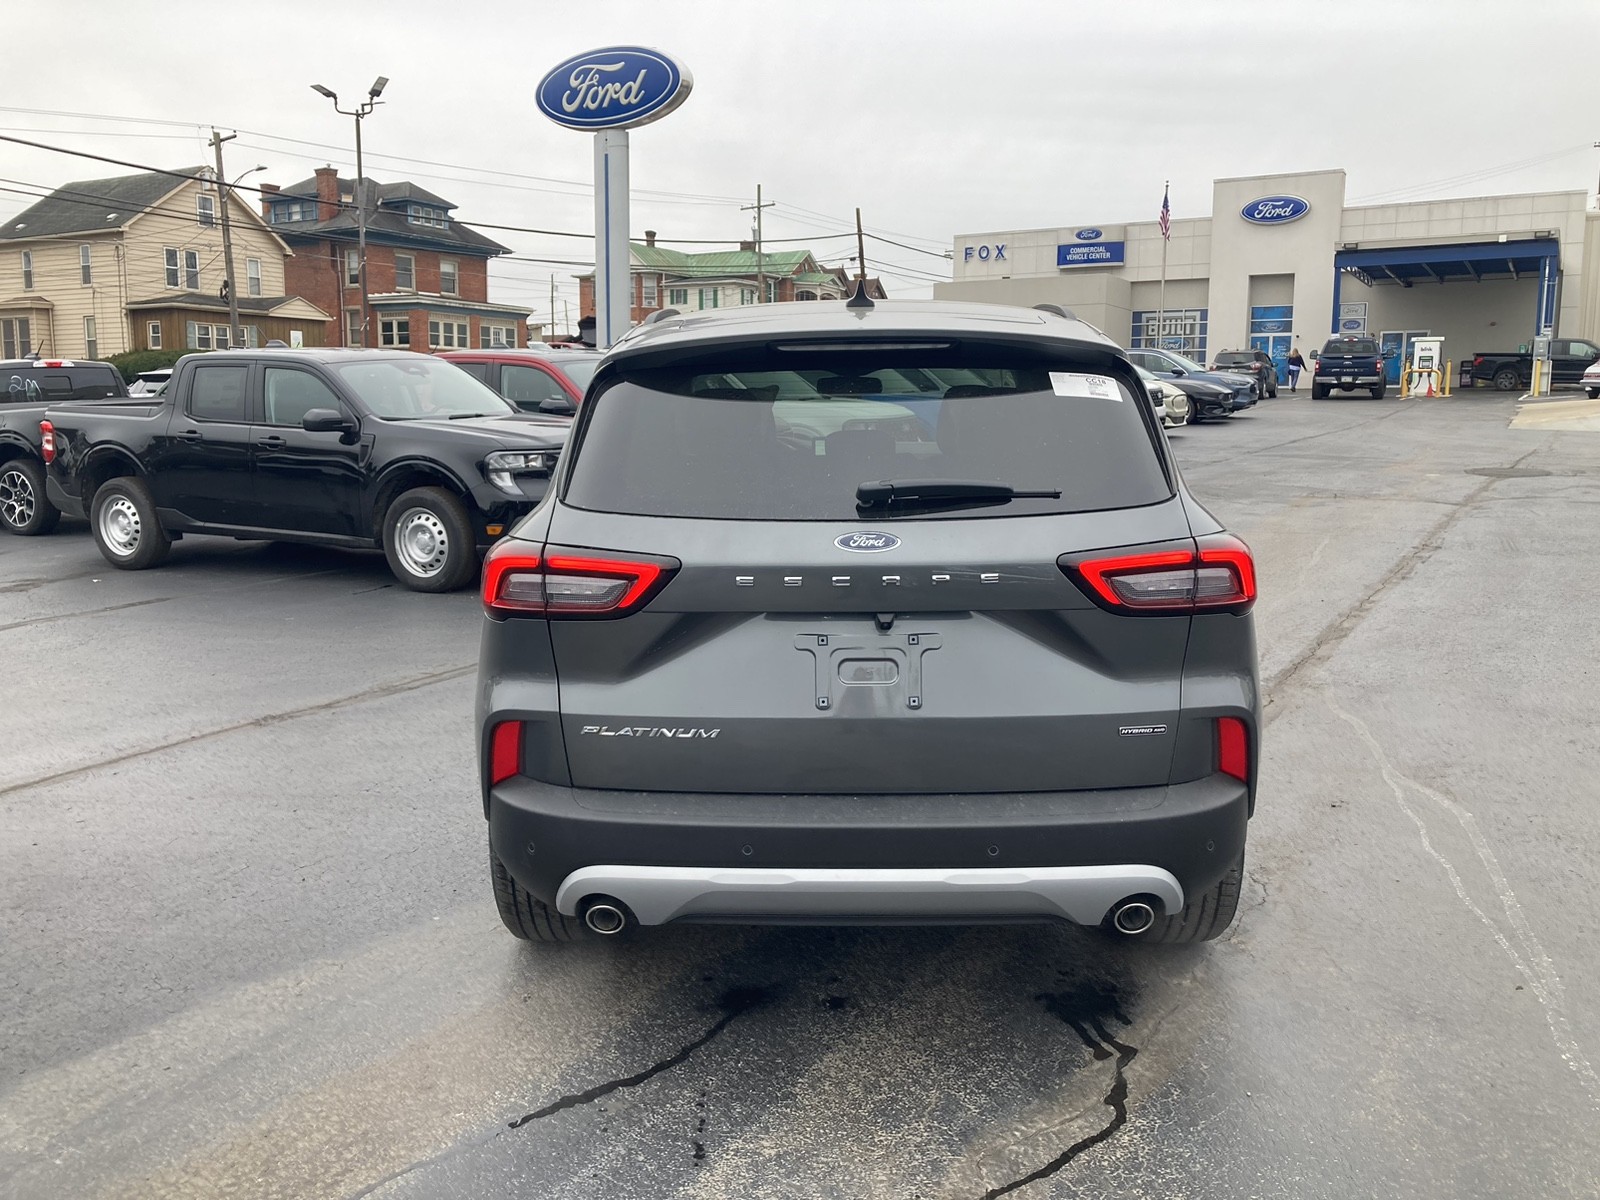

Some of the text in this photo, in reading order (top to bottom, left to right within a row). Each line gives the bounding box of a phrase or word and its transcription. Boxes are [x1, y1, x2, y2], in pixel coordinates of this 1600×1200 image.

[562, 61, 648, 113] Ford
[1254, 200, 1294, 219] Ford
[1080, 229, 1097, 239] Ford
[964, 244, 1008, 262] FOX
[1066, 252, 1111, 261] VEHICLE CENTER
[1069, 246, 1106, 254] COMMERCIAL
[1148, 318, 1194, 336] BUILT
[850, 534, 885, 548] Ford
[735, 573, 1000, 586] ESCAPE
[580, 725, 721, 738] PLATINUM
